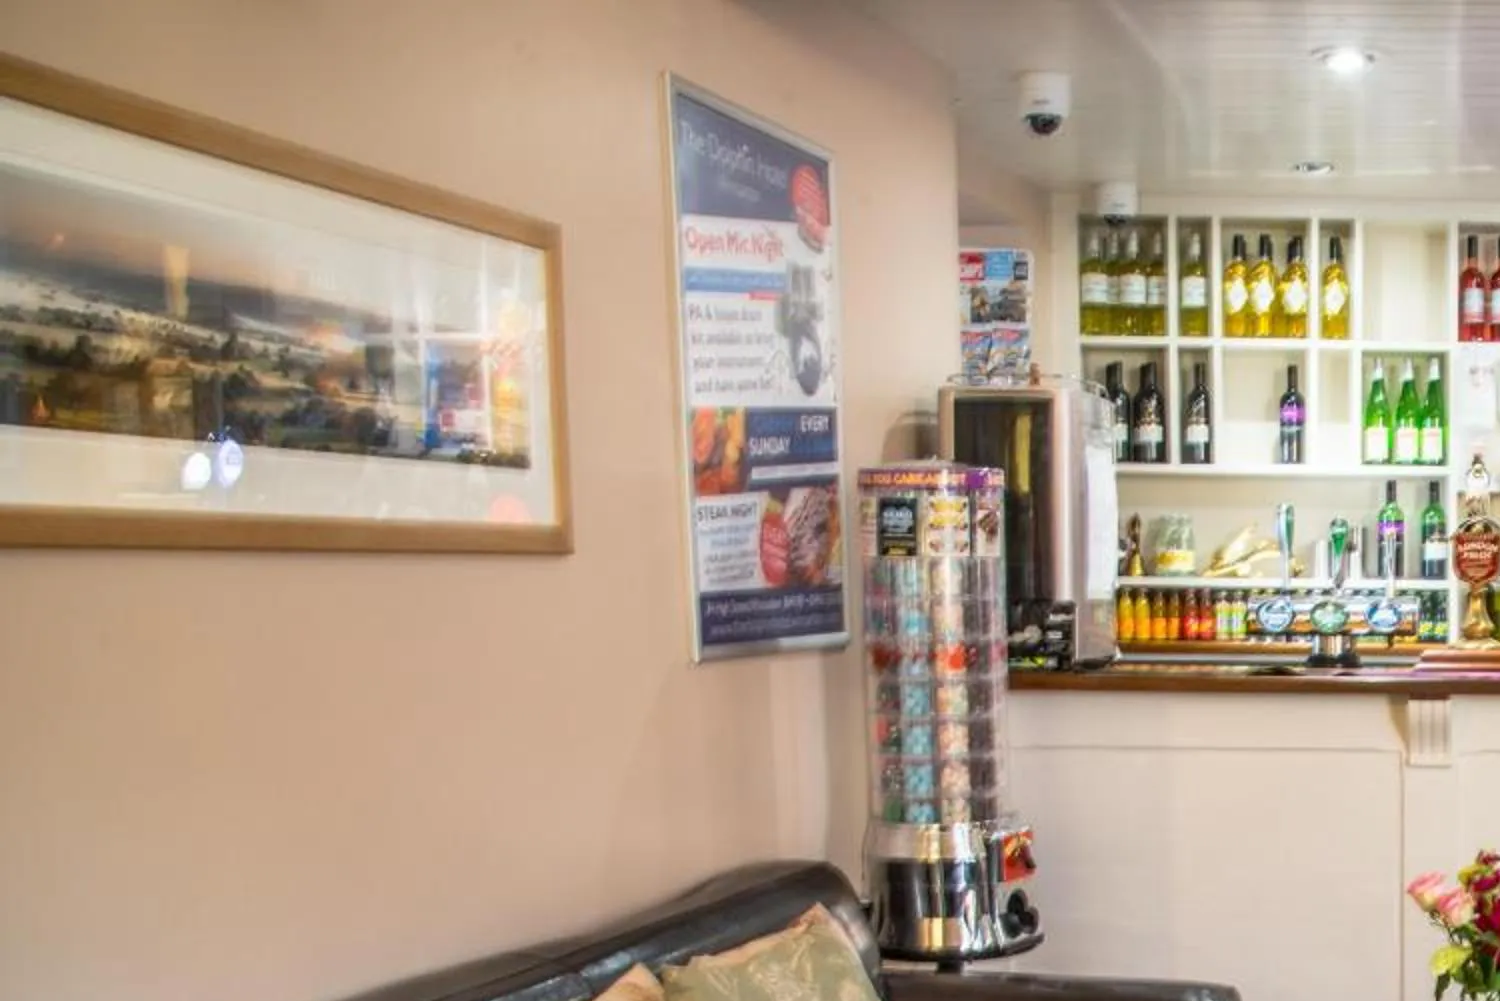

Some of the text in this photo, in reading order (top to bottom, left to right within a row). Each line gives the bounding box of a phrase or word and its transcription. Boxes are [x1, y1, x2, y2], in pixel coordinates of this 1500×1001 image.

[685, 226, 724, 257] Open
[751, 232, 784, 263] Night
[800, 414, 829, 433] EVERY
[750, 435, 791, 457] SUNDAY
